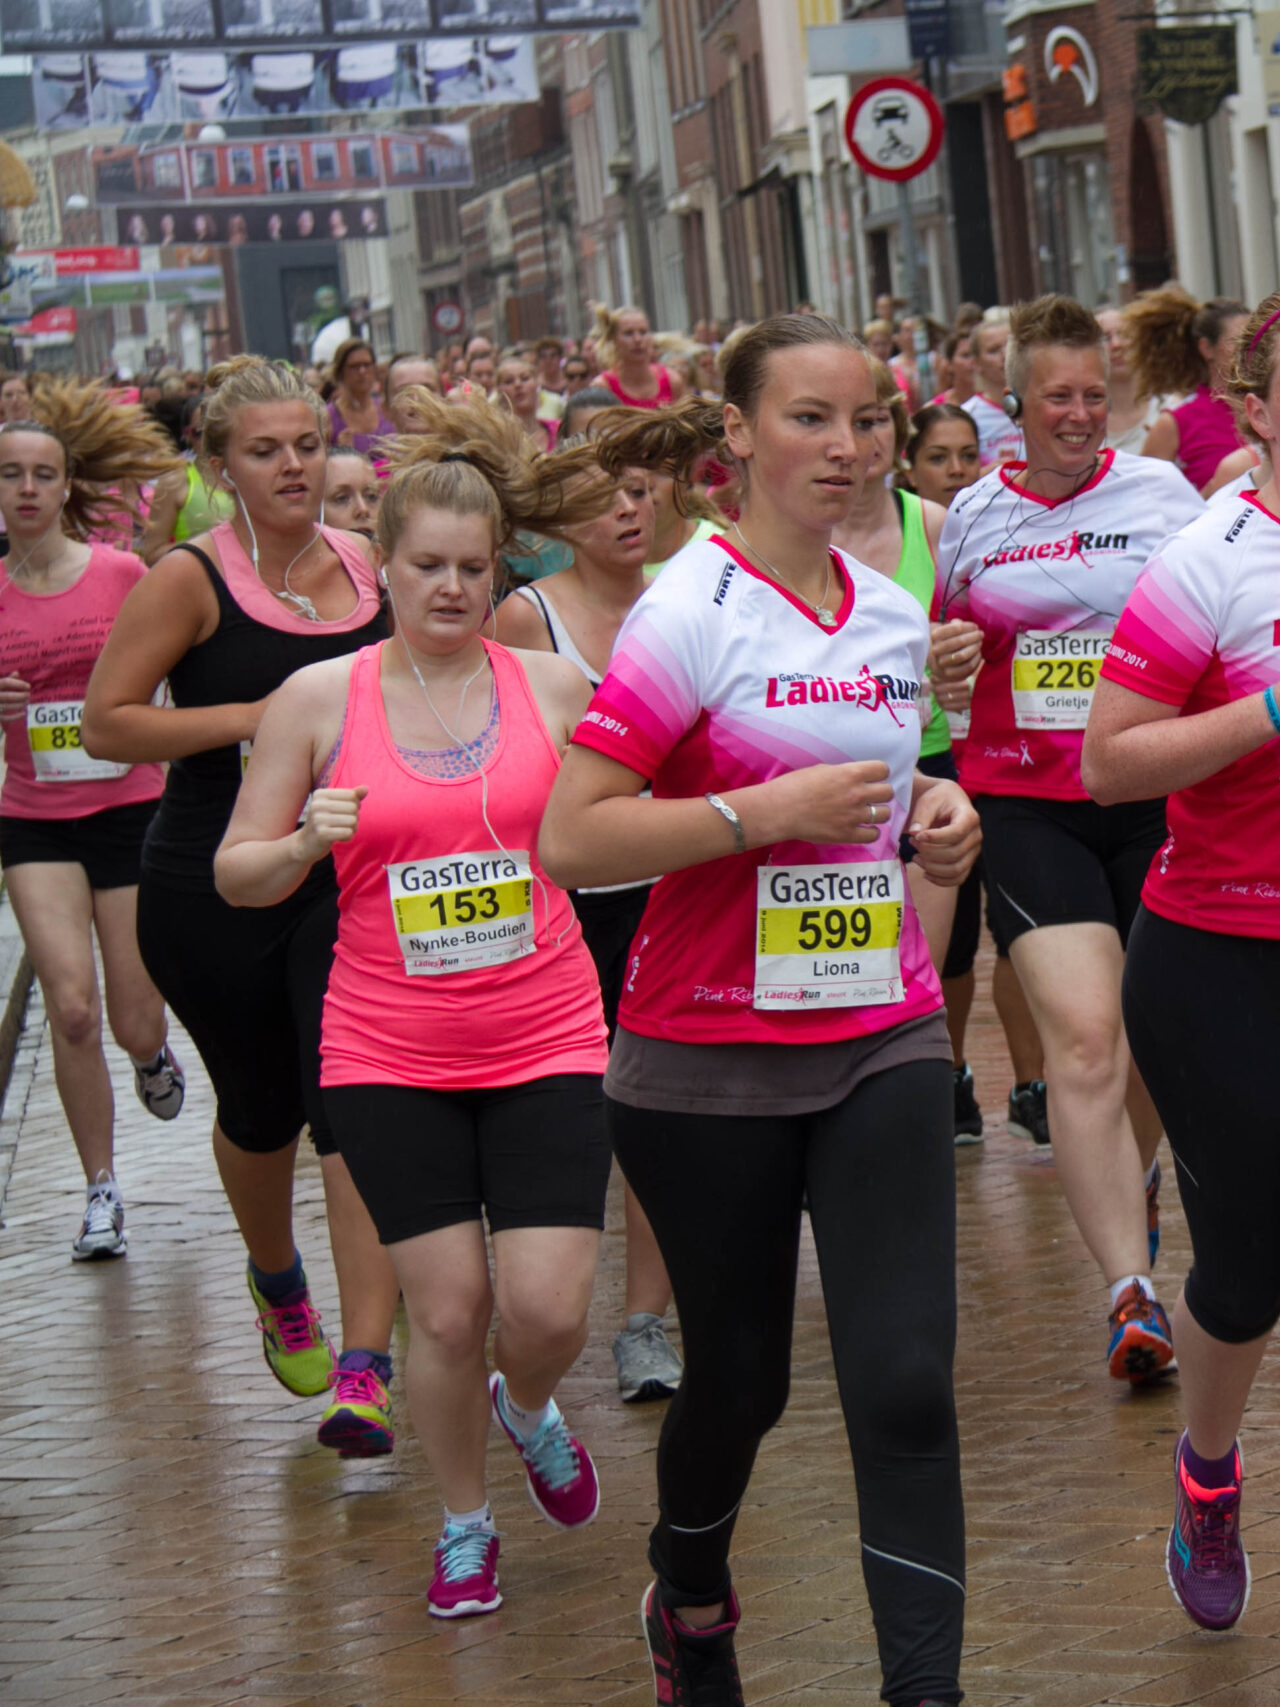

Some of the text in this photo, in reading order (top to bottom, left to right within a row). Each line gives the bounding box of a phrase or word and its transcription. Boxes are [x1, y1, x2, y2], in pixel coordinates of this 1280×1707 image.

[1078, 531, 1129, 551] Run
[1123, 651, 1148, 670] 2014
[1036, 661, 1095, 689] 226
[765, 676, 872, 708] Ladies
[1045, 695, 1089, 709] Grietje
[599, 716, 629, 737] 2014
[401, 858, 518, 892] GasTerra
[770, 871, 891, 903] GasTerra
[430, 887, 500, 926] 153
[409, 922, 526, 952] Nynke-Boudien
[798, 907, 871, 950] 599
[441, 957, 459, 966] Run
[813, 961, 860, 976] Liona
[764, 990, 797, 999] Ladies
[801, 990, 820, 999] Run
